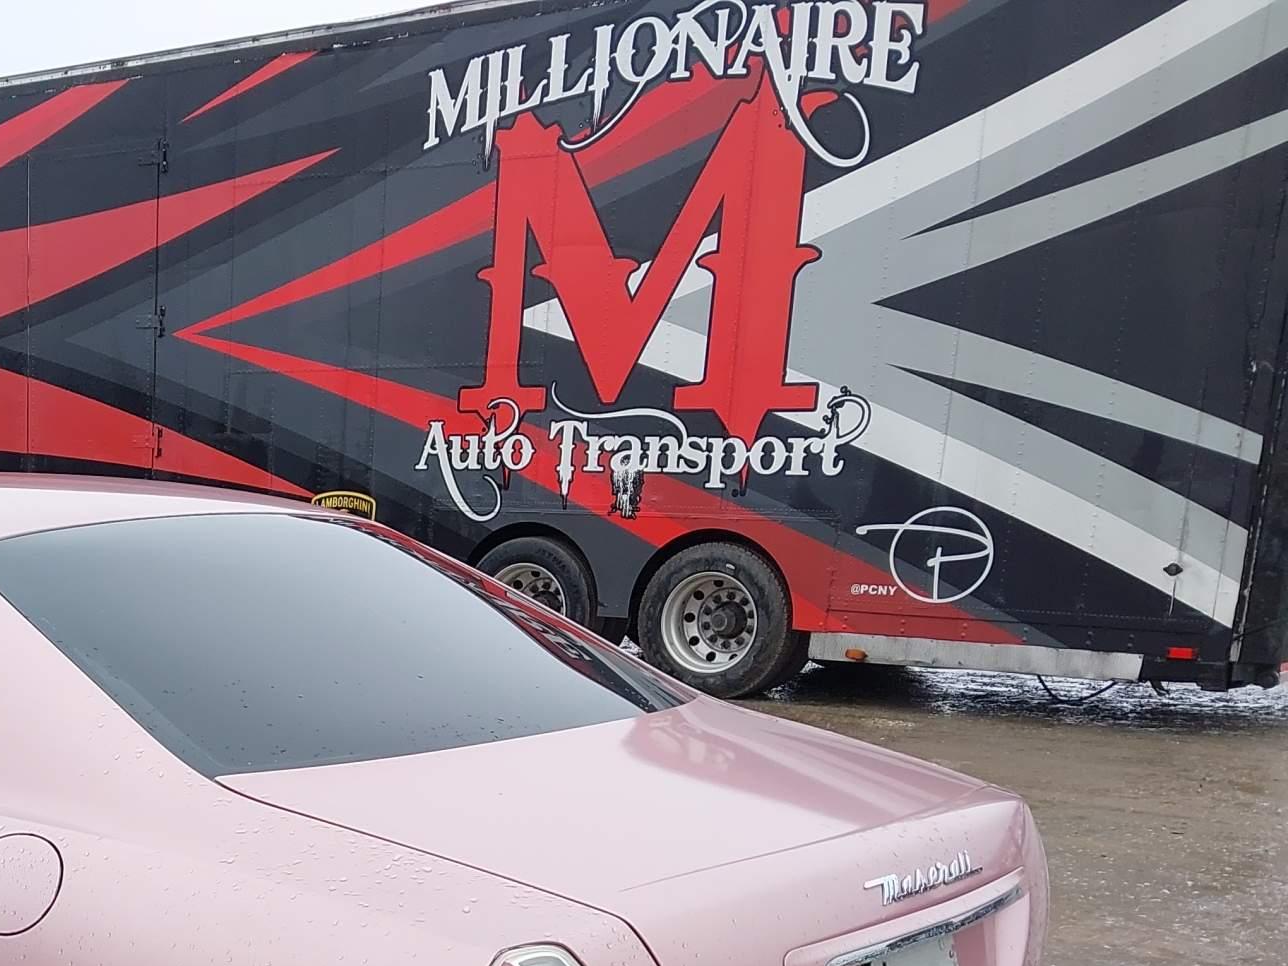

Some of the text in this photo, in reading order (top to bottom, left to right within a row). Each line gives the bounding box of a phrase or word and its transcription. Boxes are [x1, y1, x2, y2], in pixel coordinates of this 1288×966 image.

[422, 0, 928, 166] MILLIONAIRE
[458, 64, 822, 438] M
[415, 381, 872, 521] Auto Transport
[850, 583, 898, 596] @PCNY
